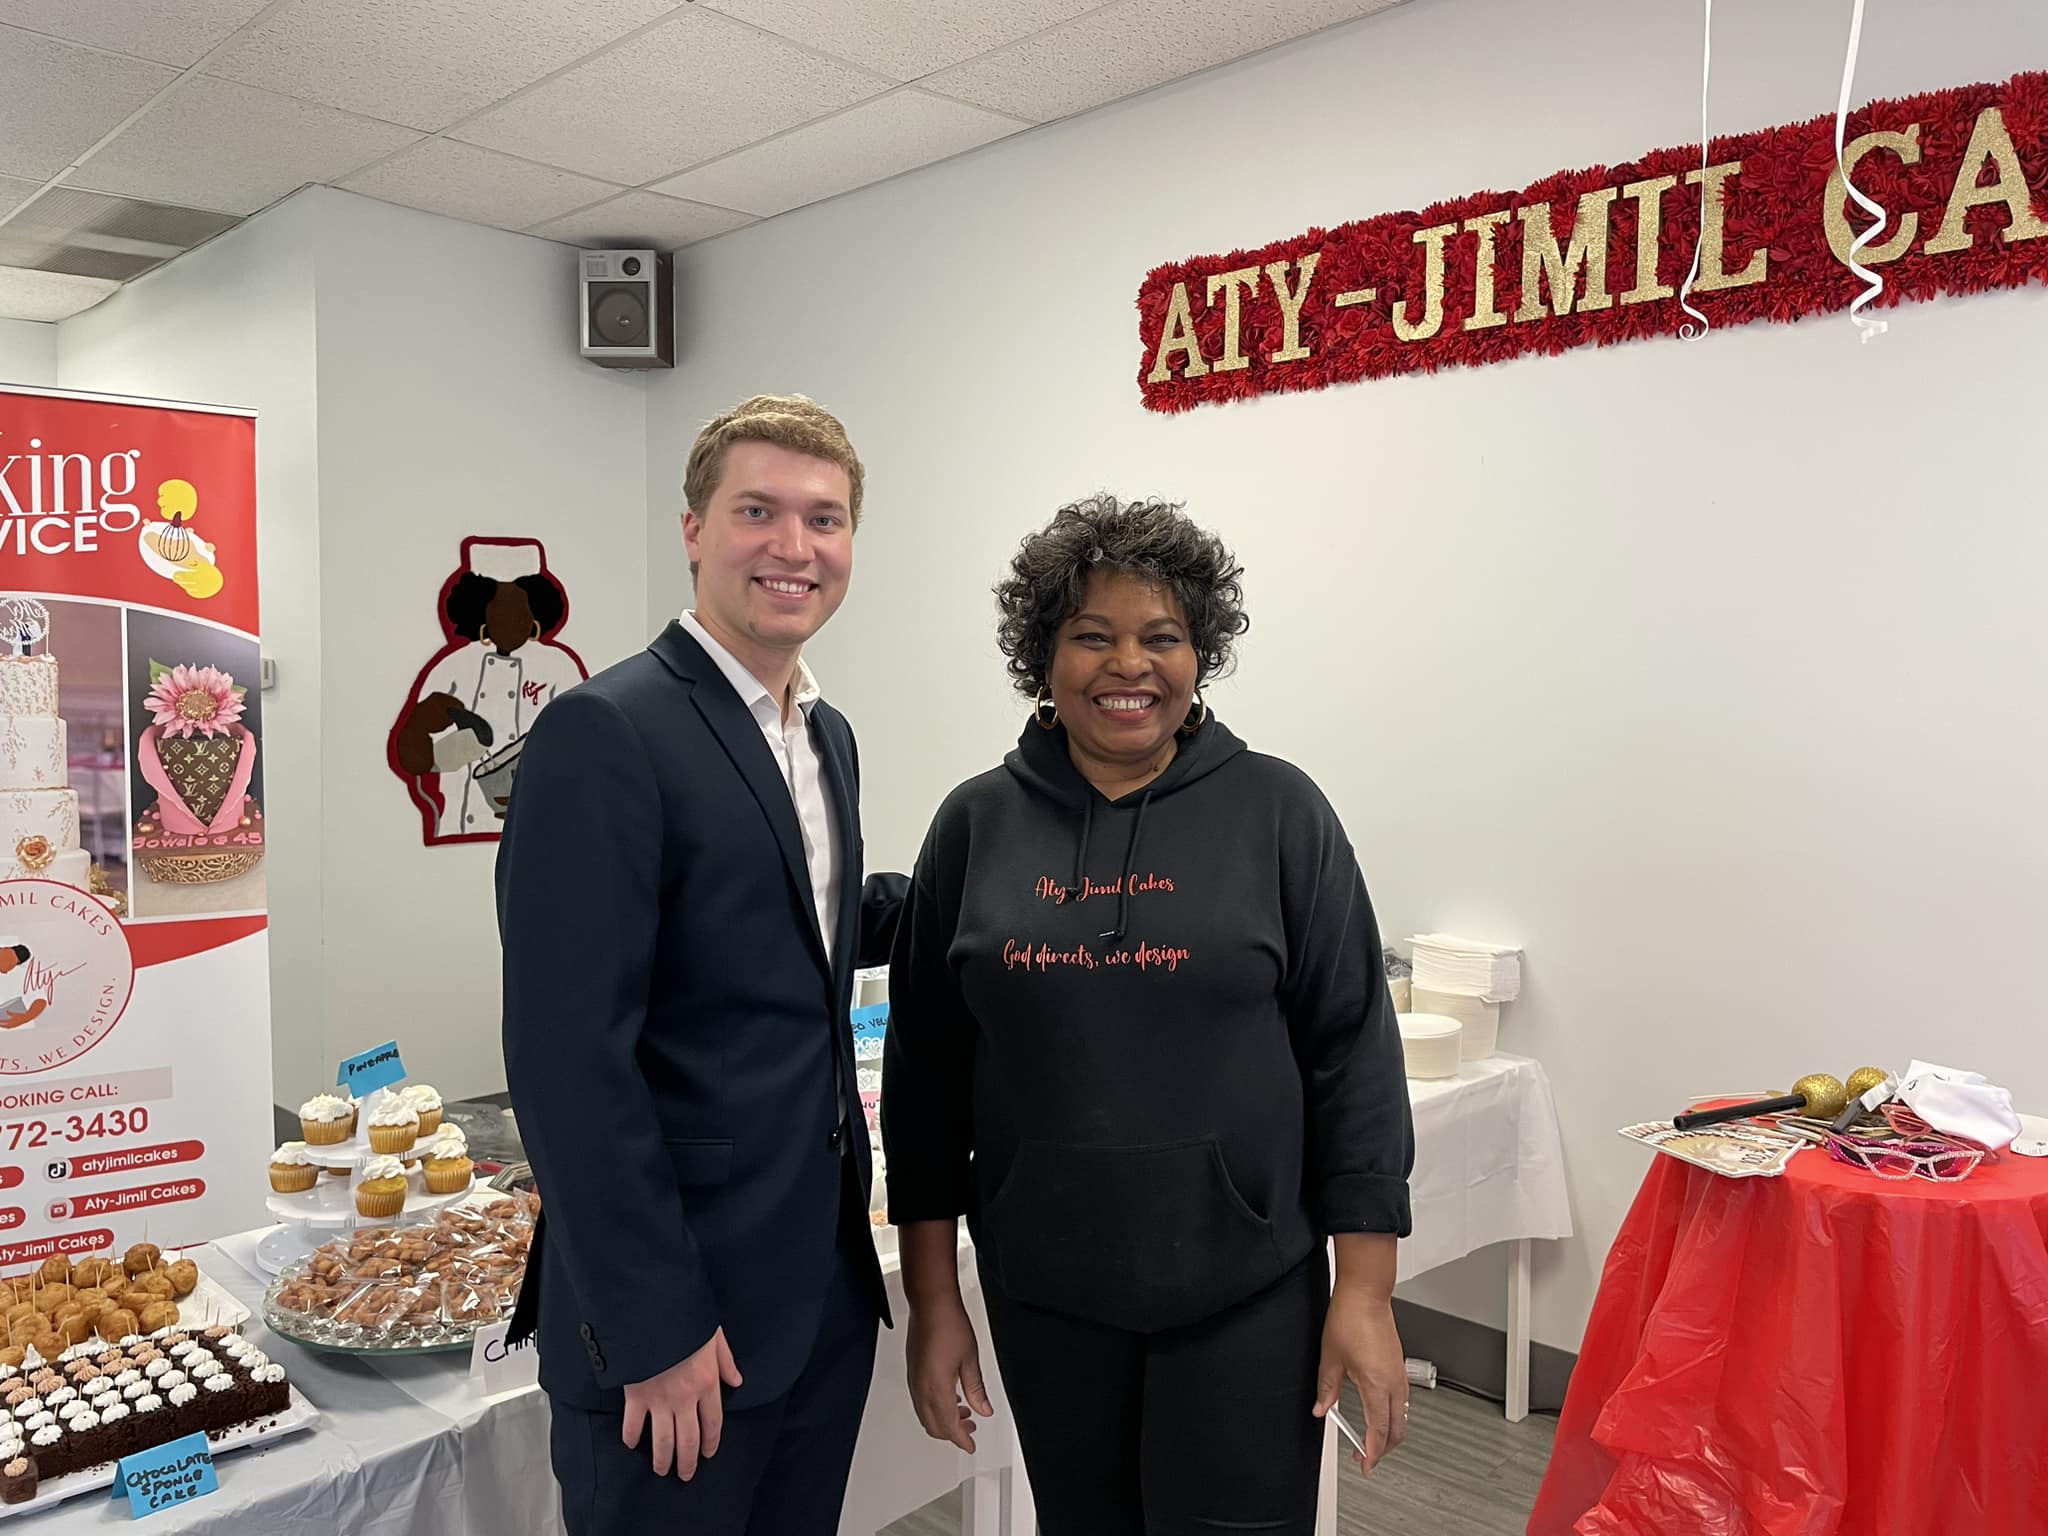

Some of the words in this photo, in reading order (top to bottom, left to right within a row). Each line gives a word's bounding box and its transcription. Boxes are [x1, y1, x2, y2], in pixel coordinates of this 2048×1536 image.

[1823, 107, 2048, 267] CA
[233, 832, 262, 844] 45
[1129, 872, 1175, 896] Cakes
[50, 895, 112, 936] CAKES
[1003, 938, 1032, 971] God
[1036, 942, 1099, 972] directs,
[1105, 950, 1131, 964] we
[1135, 941, 1191, 972] design
[868, 1016, 888, 1028] VEL
[38, 1047, 67, 1065] WE
[0, 1089, 65, 1109] OKING
[70, 1083, 118, 1100] CALL:
[0, 1107, 148, 1151] 72-3430
[82, 1148, 178, 1175] atyjimilcakes
[84, 1190, 147, 1210] Aty-Jimil
[151, 1182, 197, 1201] Cakes
[58, 1233, 105, 1249] Cakes
